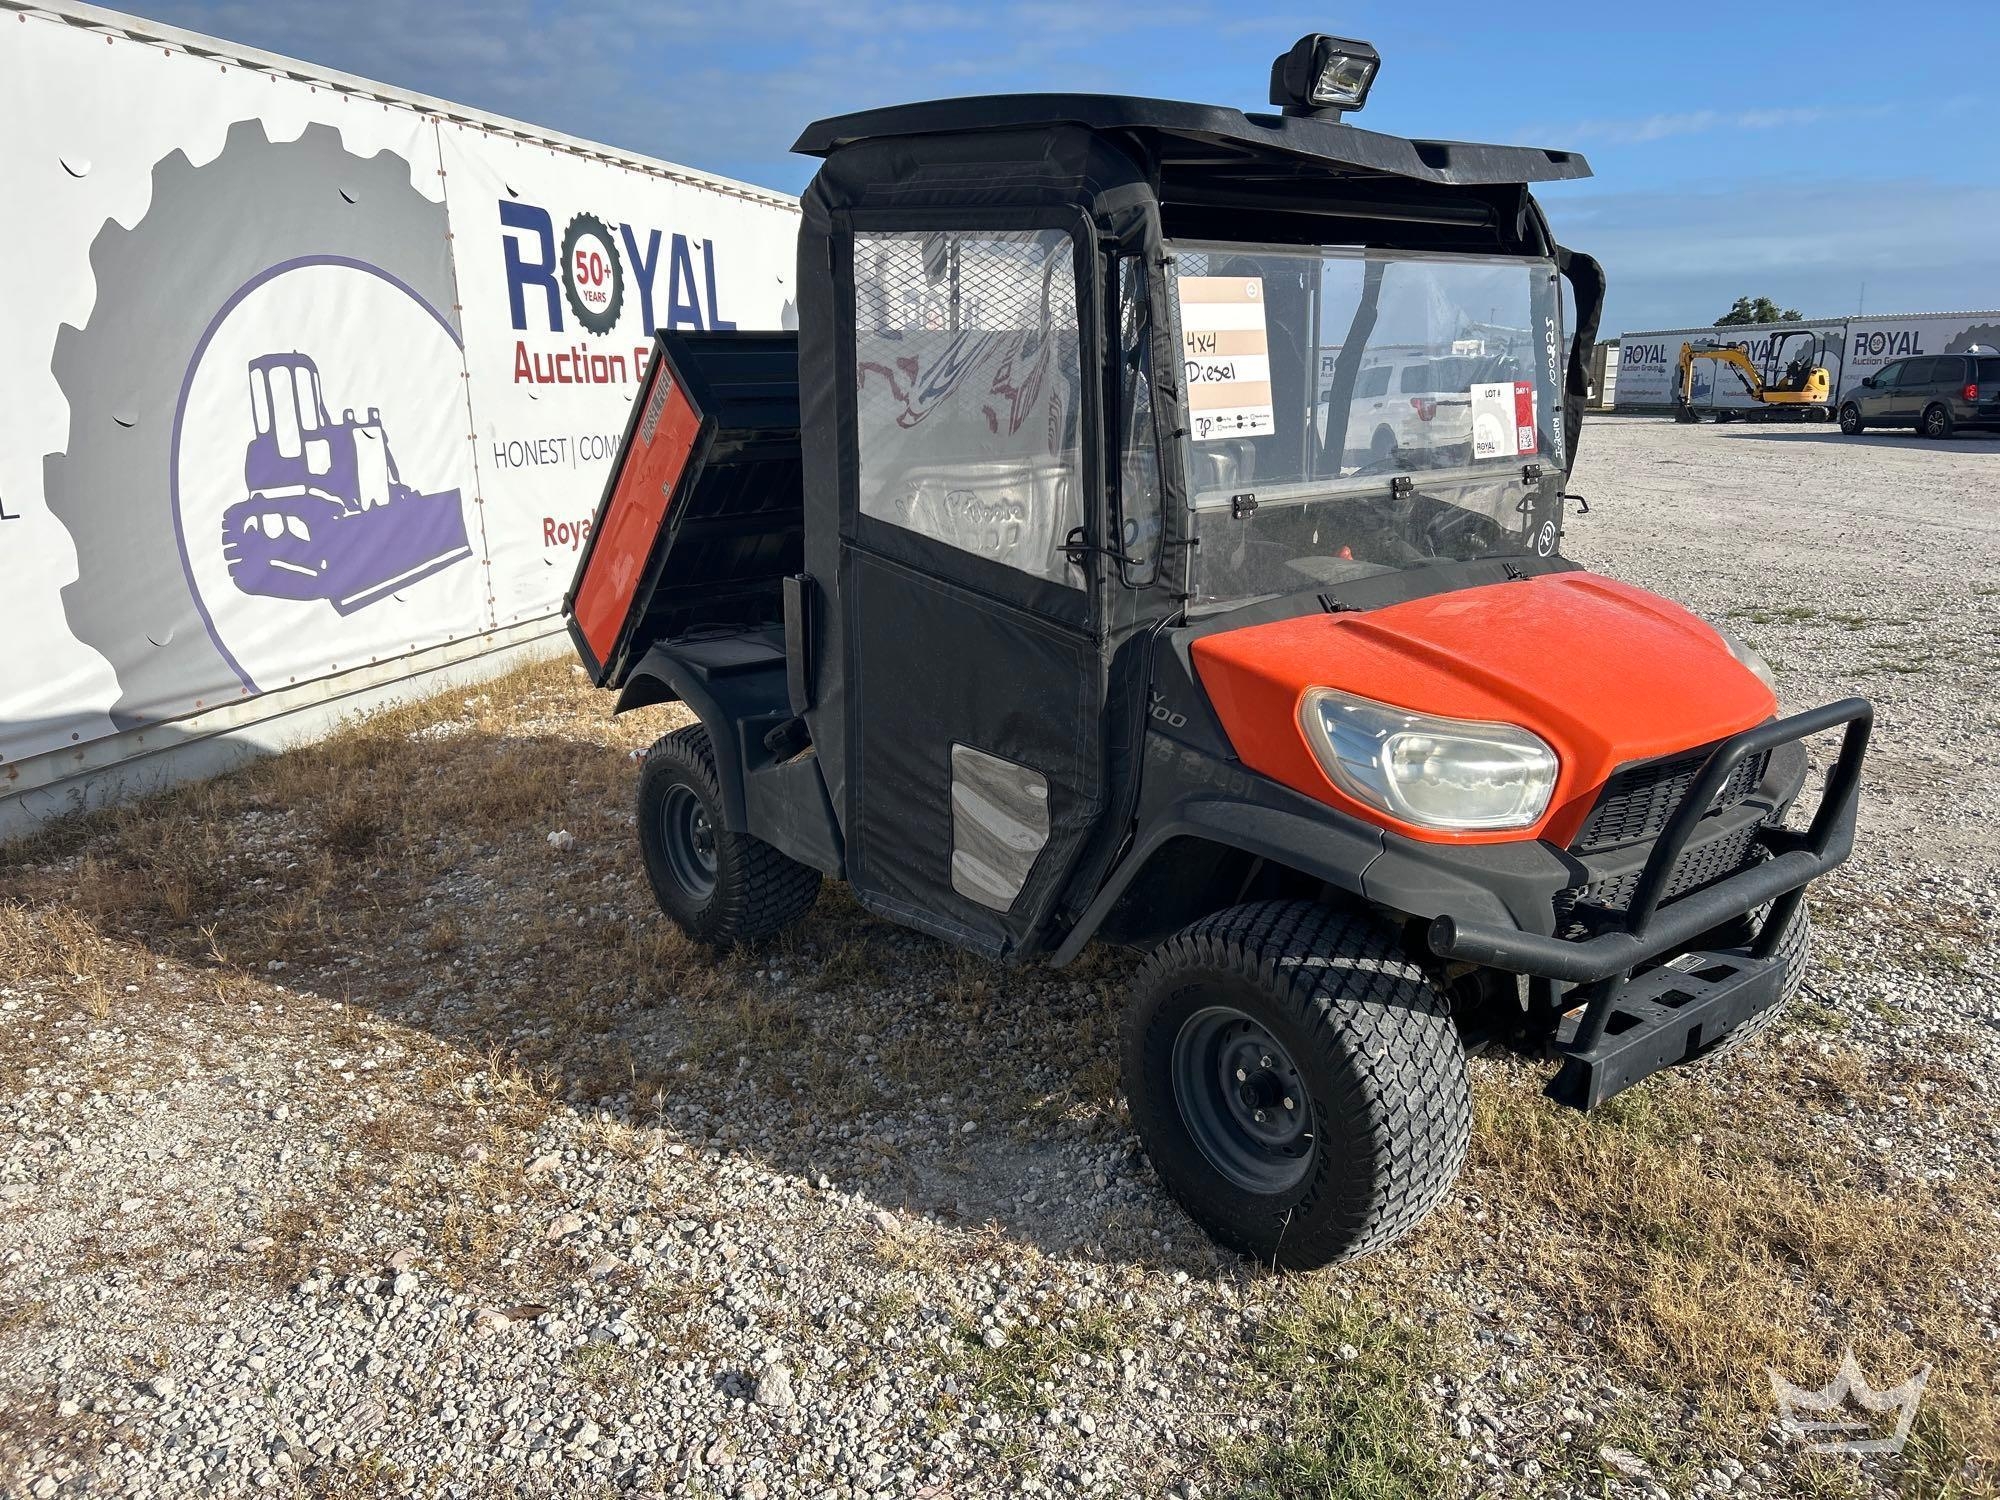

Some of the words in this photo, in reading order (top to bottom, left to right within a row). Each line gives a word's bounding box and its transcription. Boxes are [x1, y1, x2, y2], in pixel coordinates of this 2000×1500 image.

[498, 199, 737, 338] ROYAL
[576, 250, 612, 287] 50+
[583, 290, 607, 303] YEARS
[1623, 344, 1667, 364] ROYAL
[1855, 331, 1924, 356] ROYAL
[514, 340, 627, 384] Auction
[1185, 361, 1235, 383] Diesel
[1852, 357, 1882, 366] Auction
[1485, 390, 1496, 398] LOT
[1515, 387, 1526, 395] DAY
[641, 400, 661, 445] DIESEL
[655, 370, 673, 407] FUEL
[493, 438, 567, 469] HONEST
[1477, 442, 1495, 450] ROYAL
